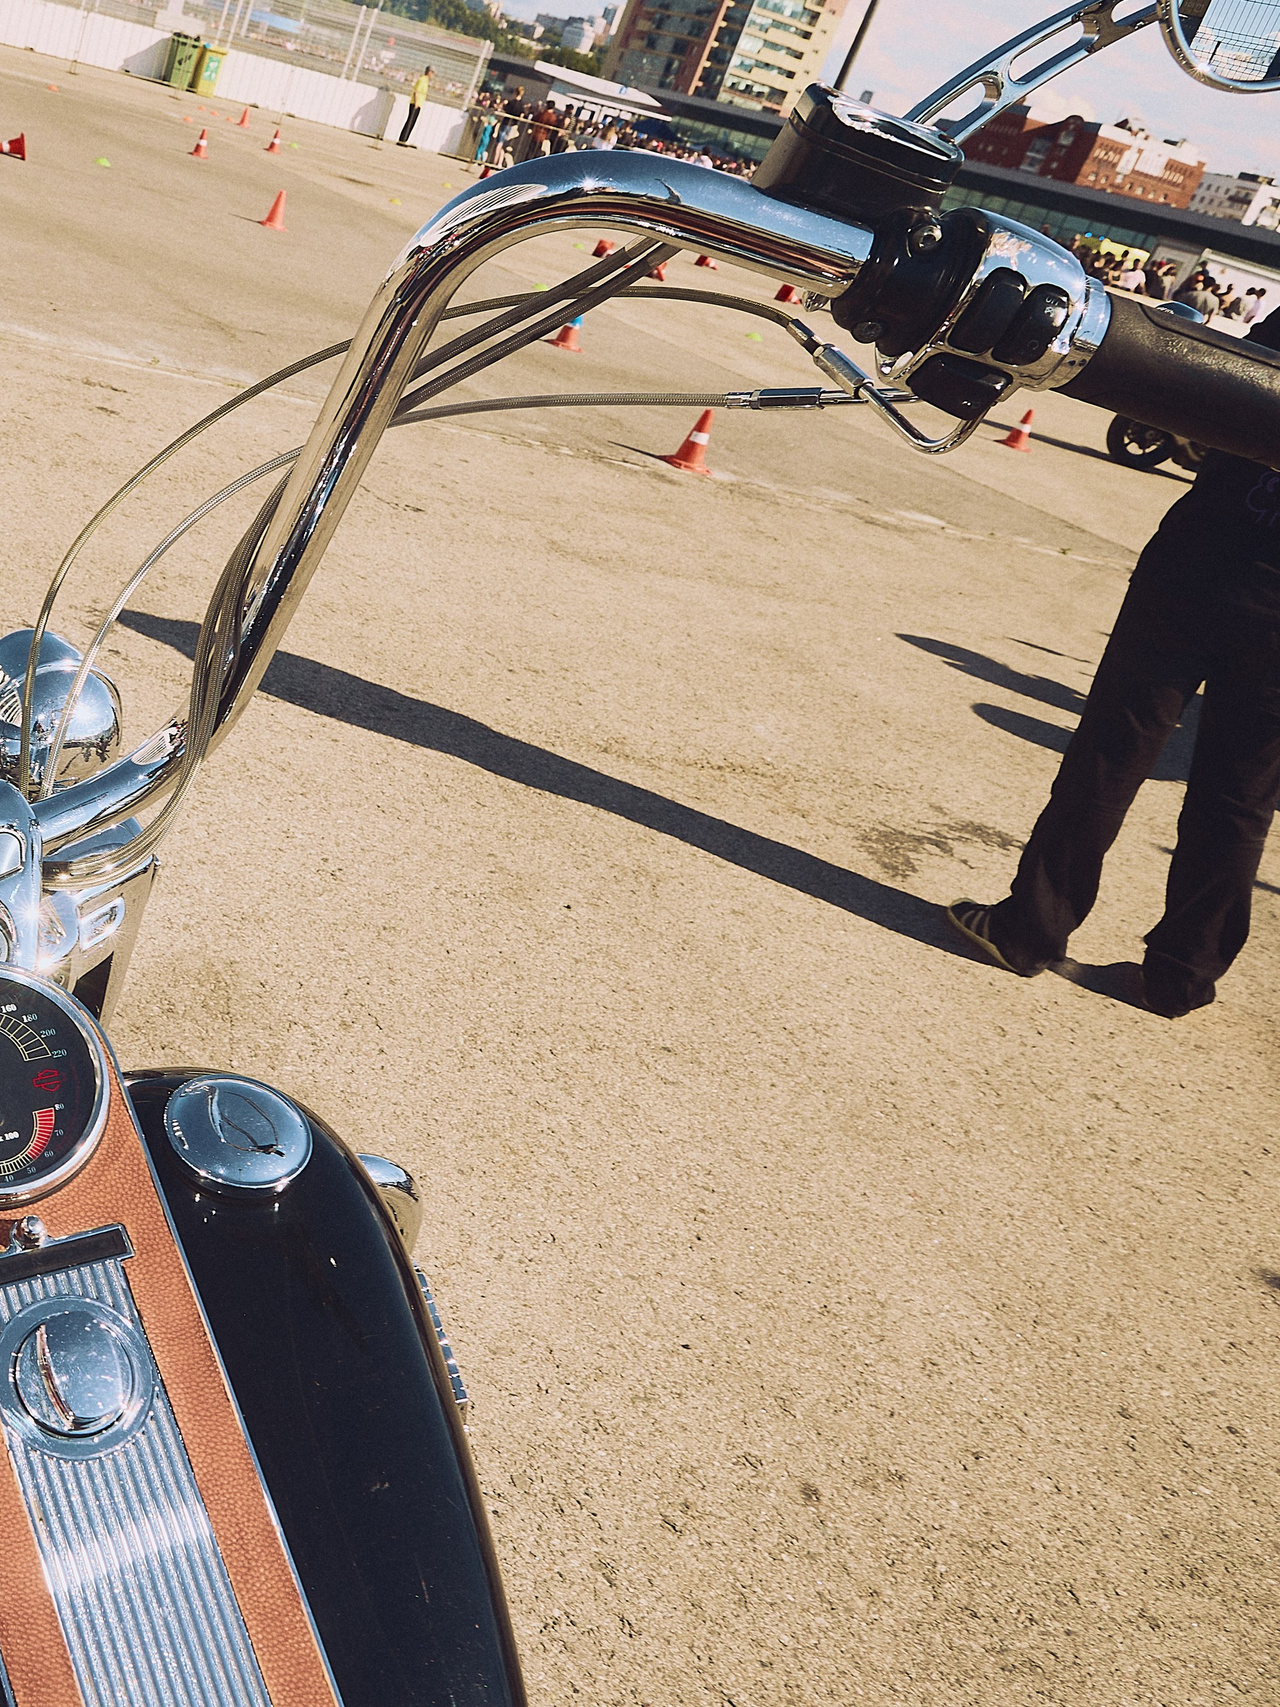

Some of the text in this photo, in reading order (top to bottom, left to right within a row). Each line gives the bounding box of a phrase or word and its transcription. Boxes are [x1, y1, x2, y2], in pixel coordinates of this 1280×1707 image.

[0, 1004, 17, 1013] 160
[22, 1014, 38, 1022] 180
[40, 1028, 56, 1038] 200
[52, 1049, 67, 1058] 220
[4, 1131, 20, 1140] 100
